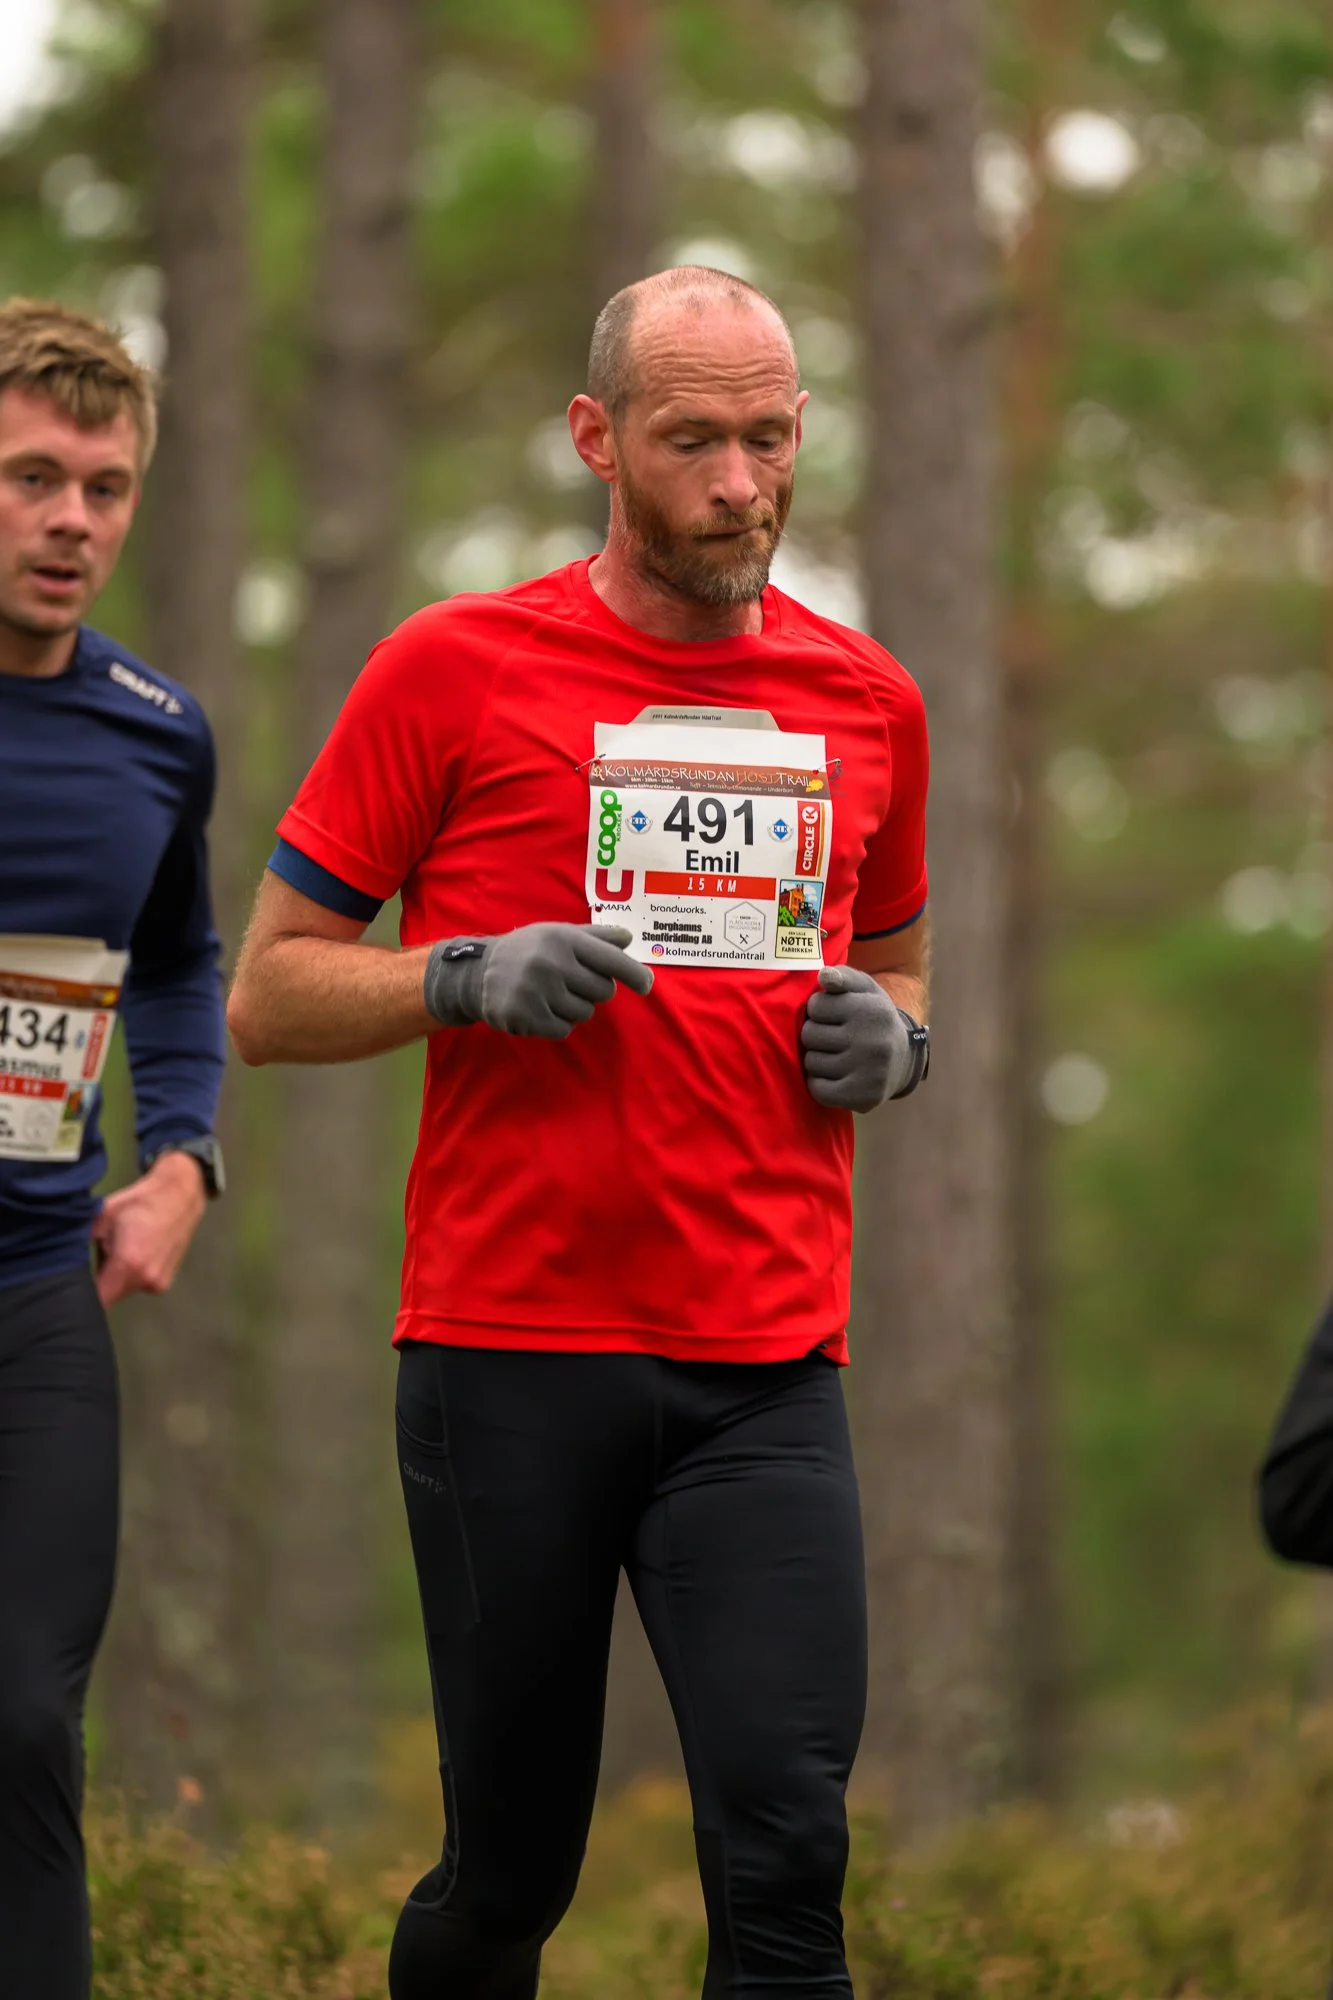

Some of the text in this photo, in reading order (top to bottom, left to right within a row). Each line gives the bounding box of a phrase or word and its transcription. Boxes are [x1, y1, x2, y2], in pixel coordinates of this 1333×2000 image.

[604, 764, 735, 783] KOLMÅRDSRUNDAN
[597, 789, 622, 867] coop
[663, 795, 754, 846] 491
[802, 809, 817, 872] CIRCLE K
[685, 849, 739, 874] Emil
[687, 879, 737, 893] 15 KM
[650, 903, 707, 915] brandworks.
[653, 920, 702, 933] Borghamns
[641, 931, 713, 945] Stenförädling AB
[780, 935, 814, 947] NØTTE
[665, 946, 765, 961] kolmardsrundantrail
[781, 946, 813, 954] FABRIKKEN
[403, 1461, 435, 1488] CRAFT
